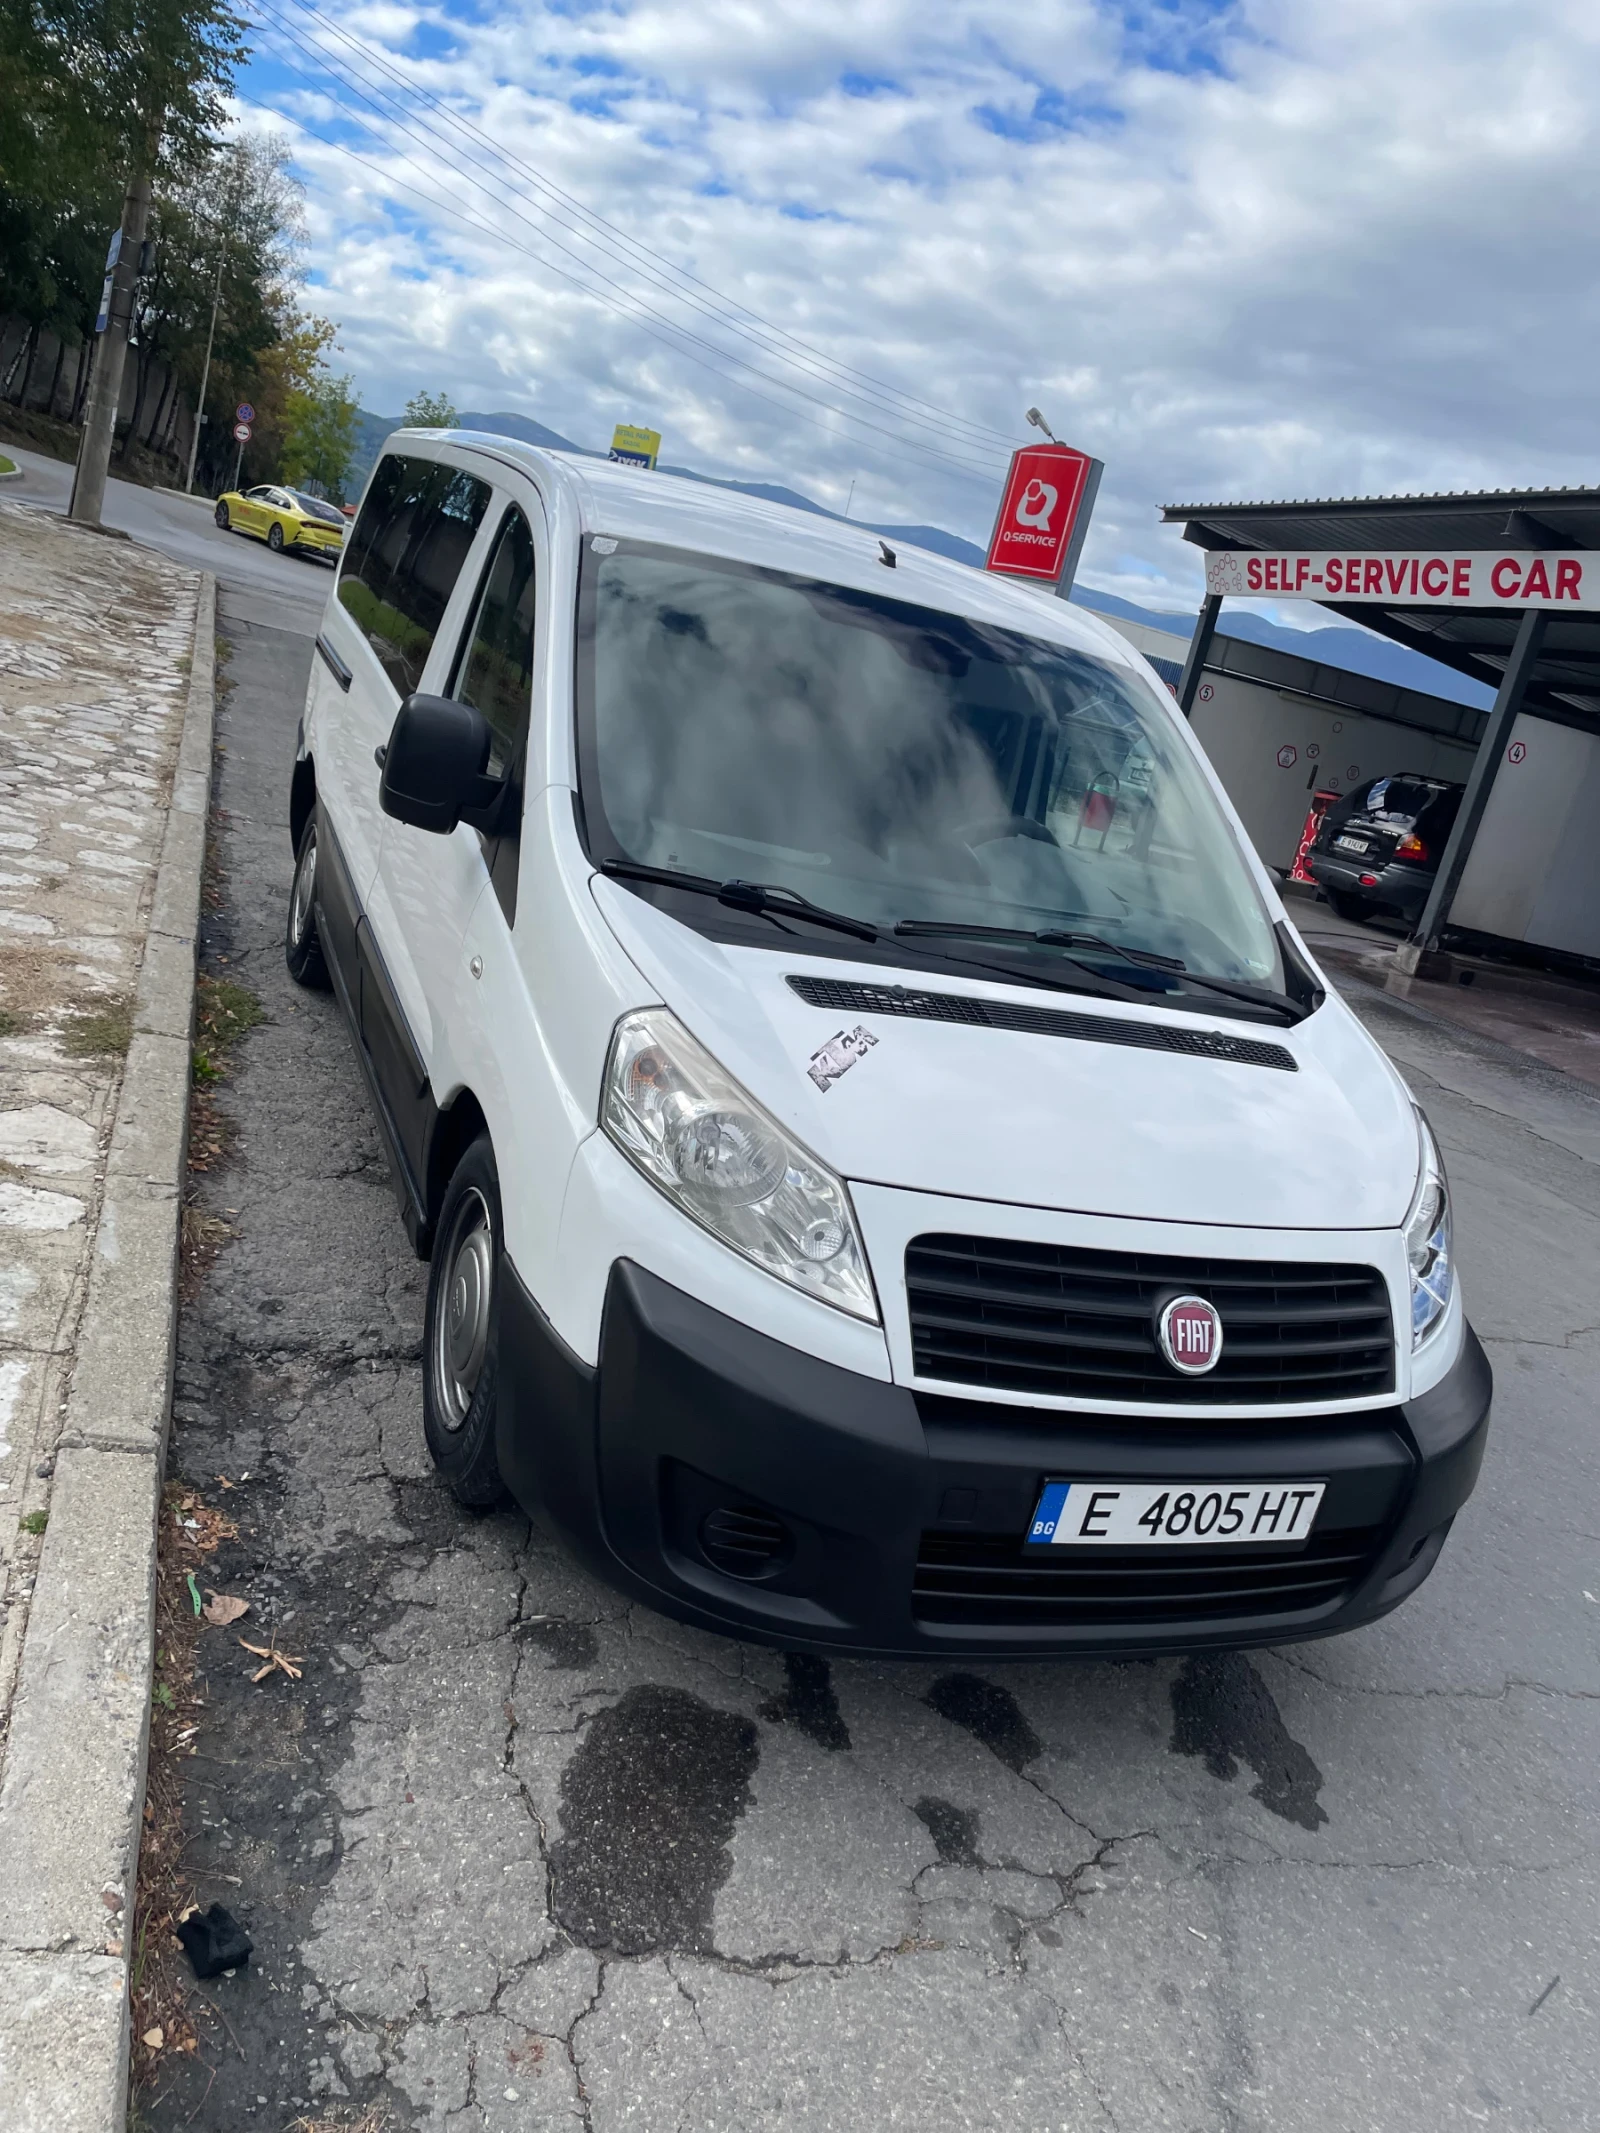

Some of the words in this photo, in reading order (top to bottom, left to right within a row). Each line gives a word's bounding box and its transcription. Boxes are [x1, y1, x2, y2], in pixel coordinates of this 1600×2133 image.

[1247, 557, 1472, 597] SELF-SERVICE
[1490, 558, 1582, 600] CAR
[1203, 687, 1210, 699] 5
[1513, 745, 1521, 761] 4
[1176, 1318, 1212, 1353] FIAT
[1078, 1492, 1121, 1537] E
[1137, 1491, 1250, 1537] 4805
[1249, 1491, 1317, 1534] HT
[1032, 1521, 1054, 1535] BG
